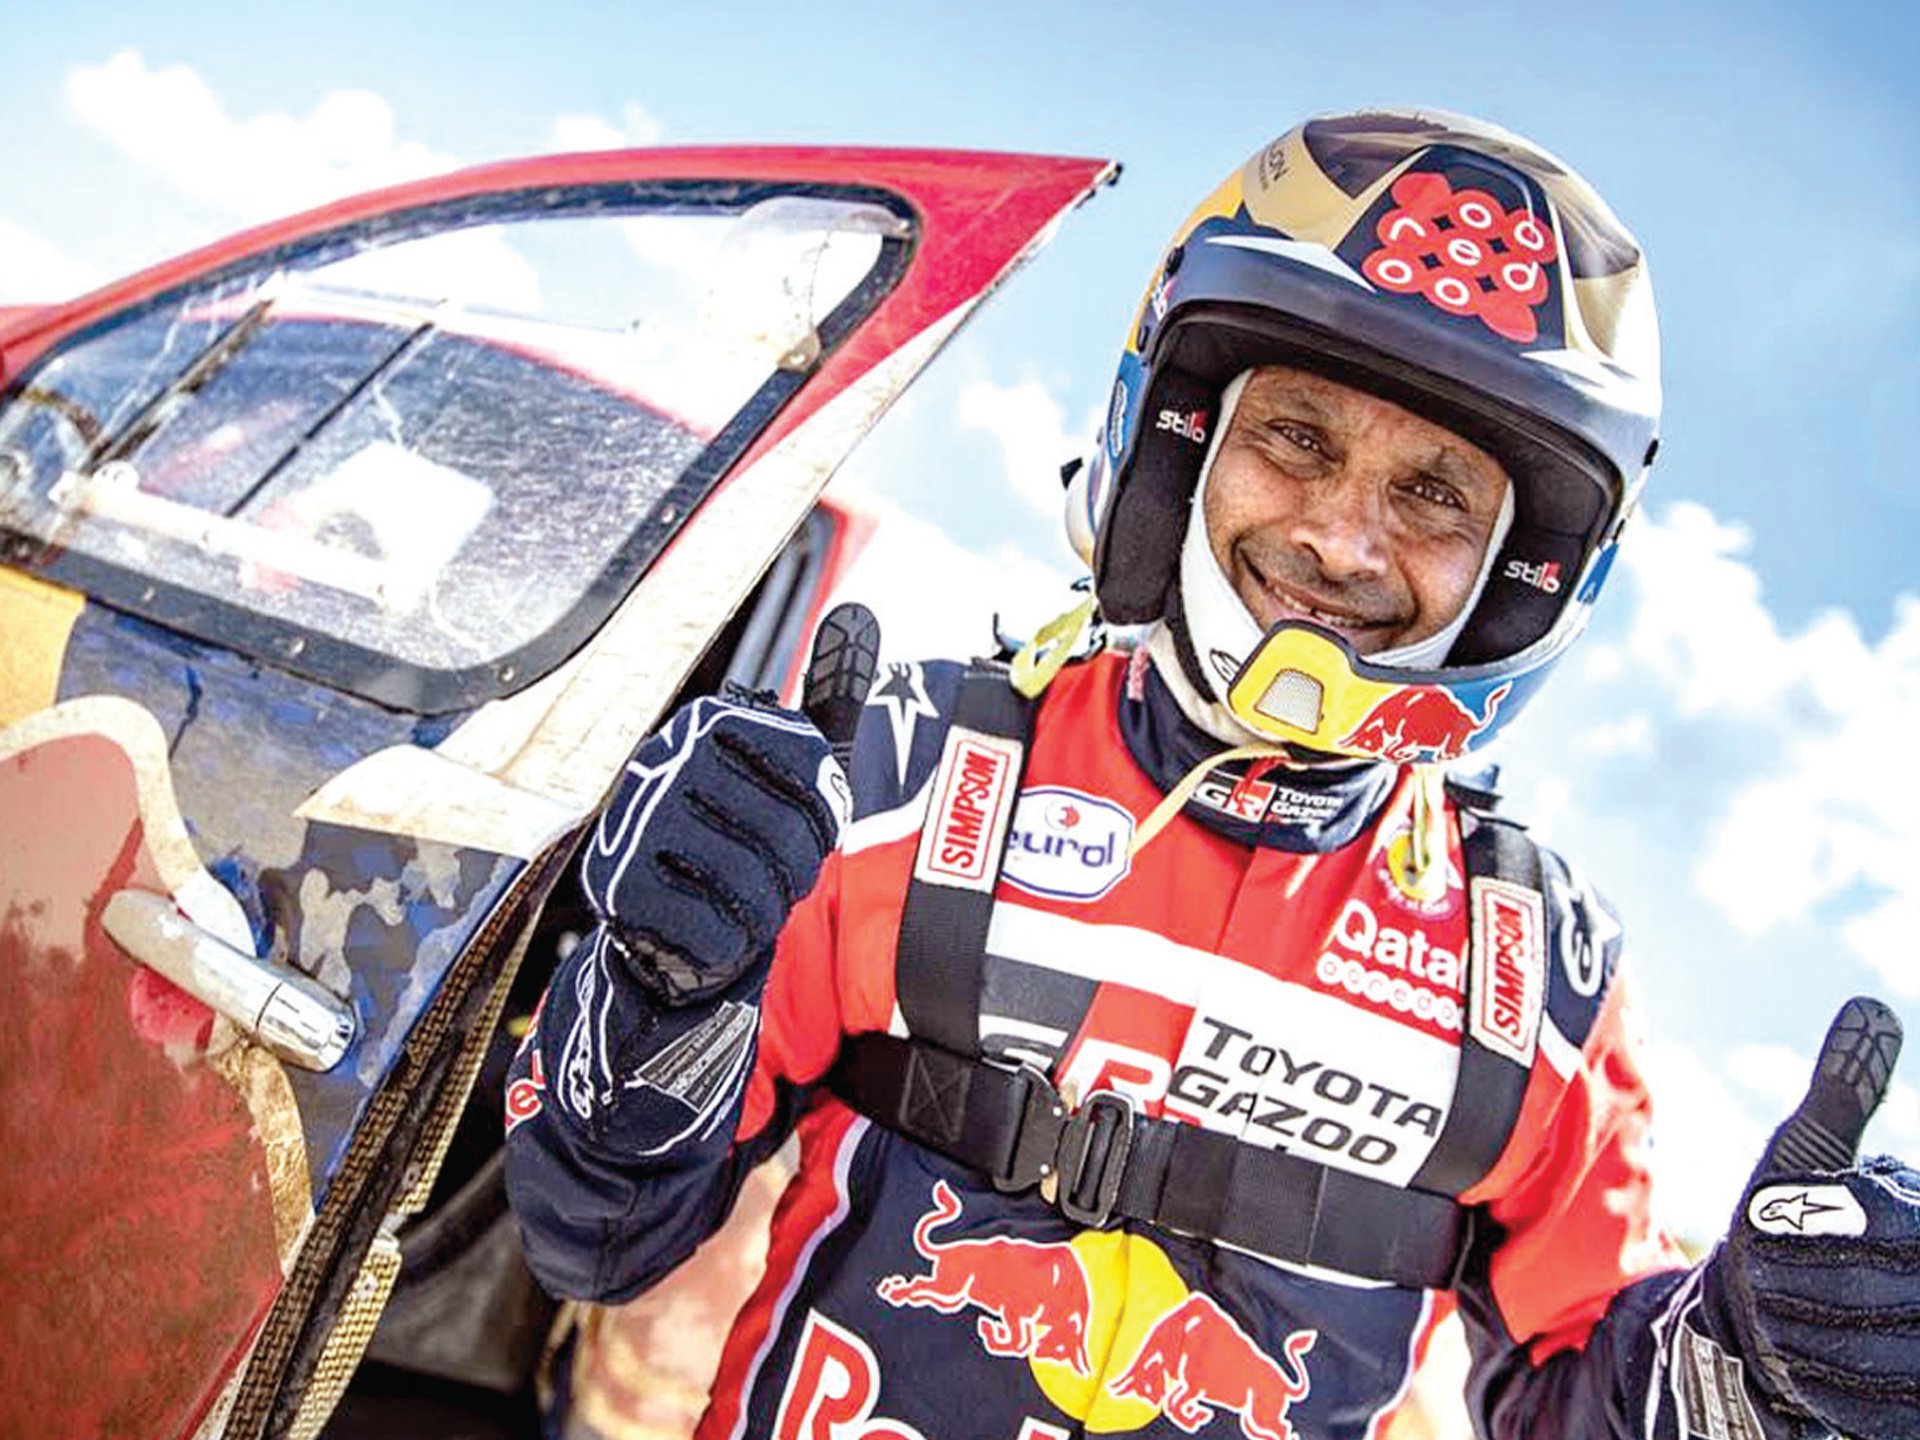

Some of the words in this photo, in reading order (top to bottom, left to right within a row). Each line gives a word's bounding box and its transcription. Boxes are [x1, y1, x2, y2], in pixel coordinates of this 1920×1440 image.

[1155, 409, 1206, 443] stilo
[1503, 561, 1560, 593] stilo
[941, 750, 999, 869] SIMPSON
[1318, 953, 1461, 1030] ooredo
[1493, 903, 1523, 1038] SIMPSON
[1168, 1063, 1398, 1167] GAZOO
[1203, 1016, 1444, 1138] TOYOTA
